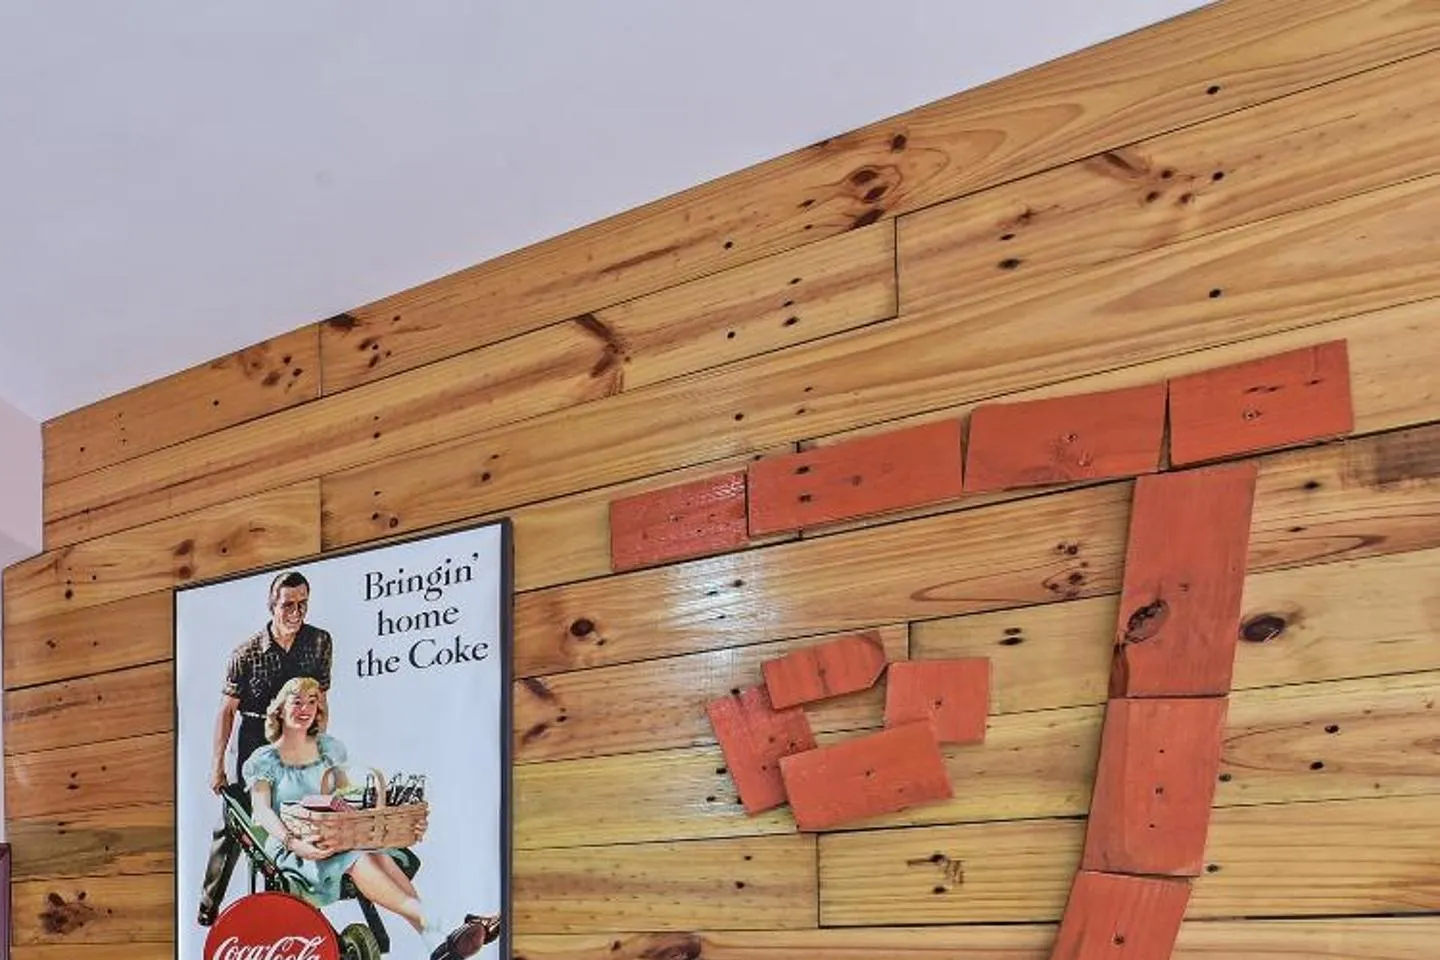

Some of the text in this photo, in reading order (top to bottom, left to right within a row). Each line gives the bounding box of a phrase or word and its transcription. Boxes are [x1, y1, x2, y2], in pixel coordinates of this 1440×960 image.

[364, 552, 479, 602] Bringin'
[377, 607, 459, 637] home
[356, 635, 489, 678] the Coke
